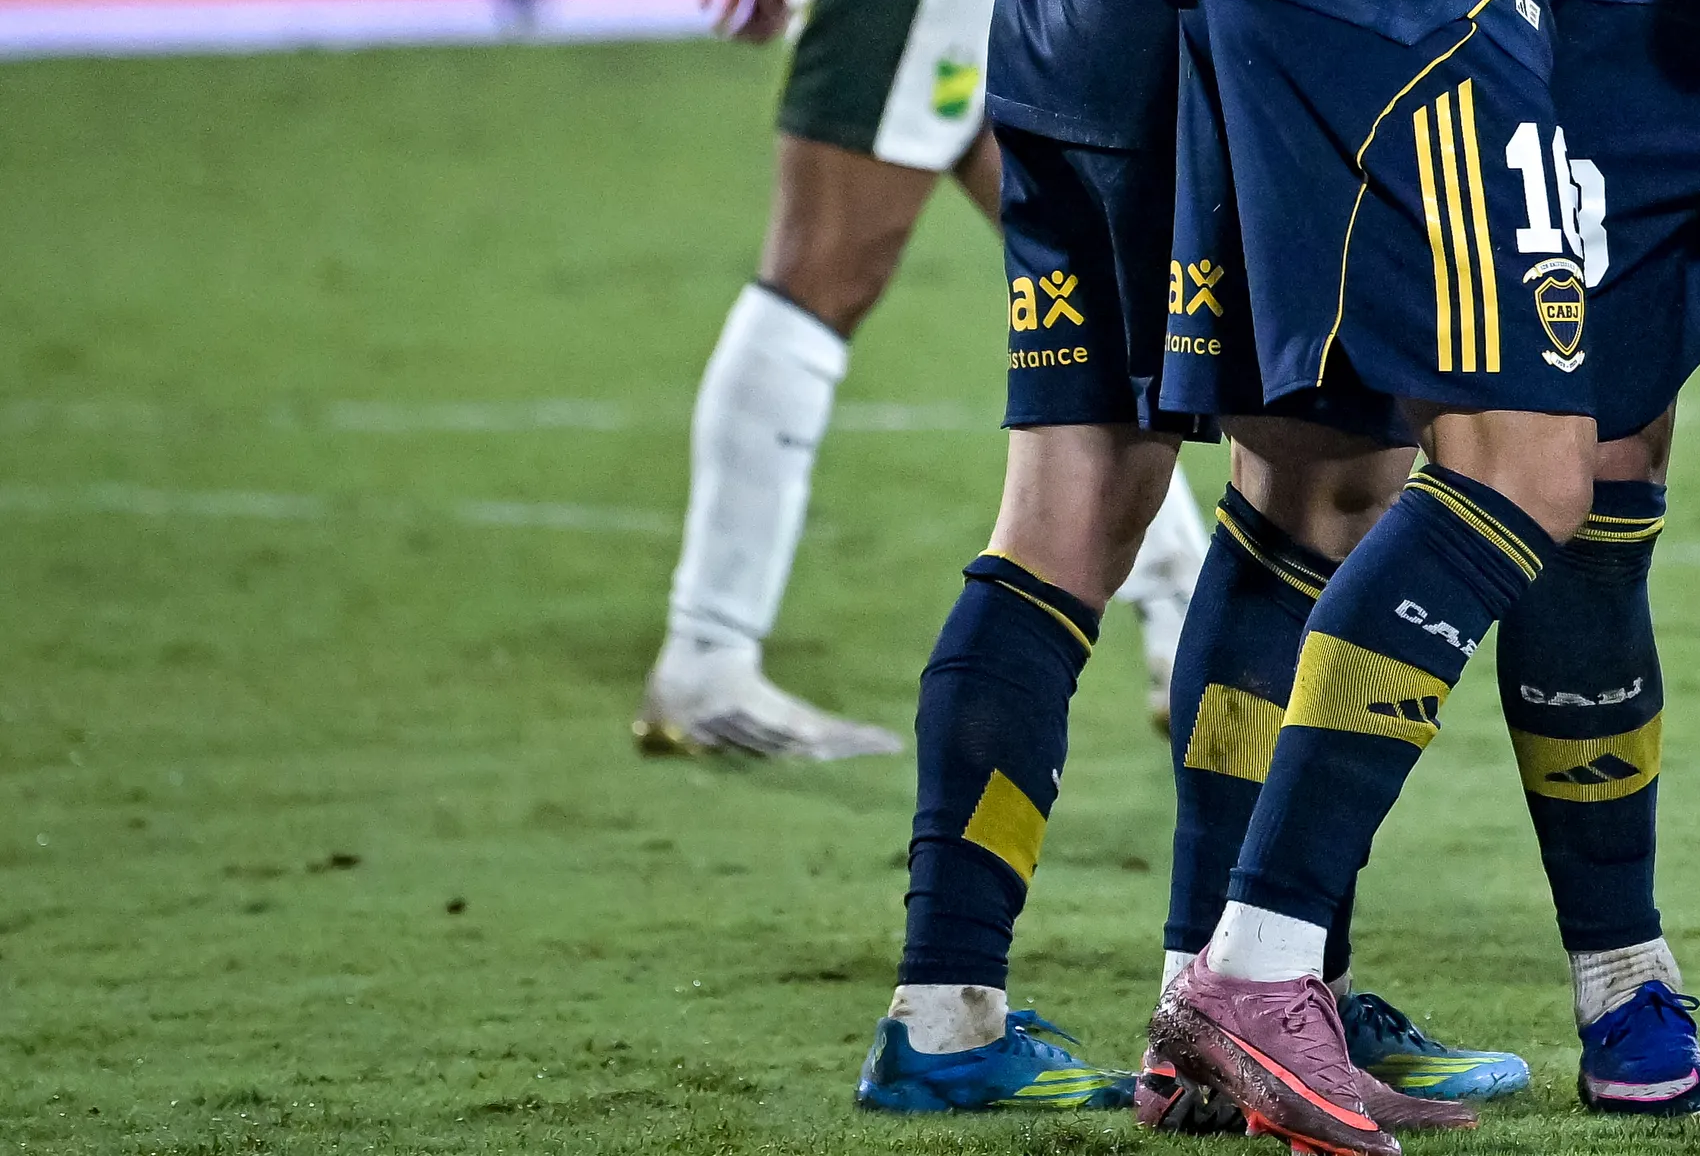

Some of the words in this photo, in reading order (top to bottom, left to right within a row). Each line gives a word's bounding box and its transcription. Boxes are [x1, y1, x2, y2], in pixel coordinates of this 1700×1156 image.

[1007, 269, 1085, 332] ax
[1168, 258, 1225, 318] ax
[1546, 305, 1579, 319] CABJ
